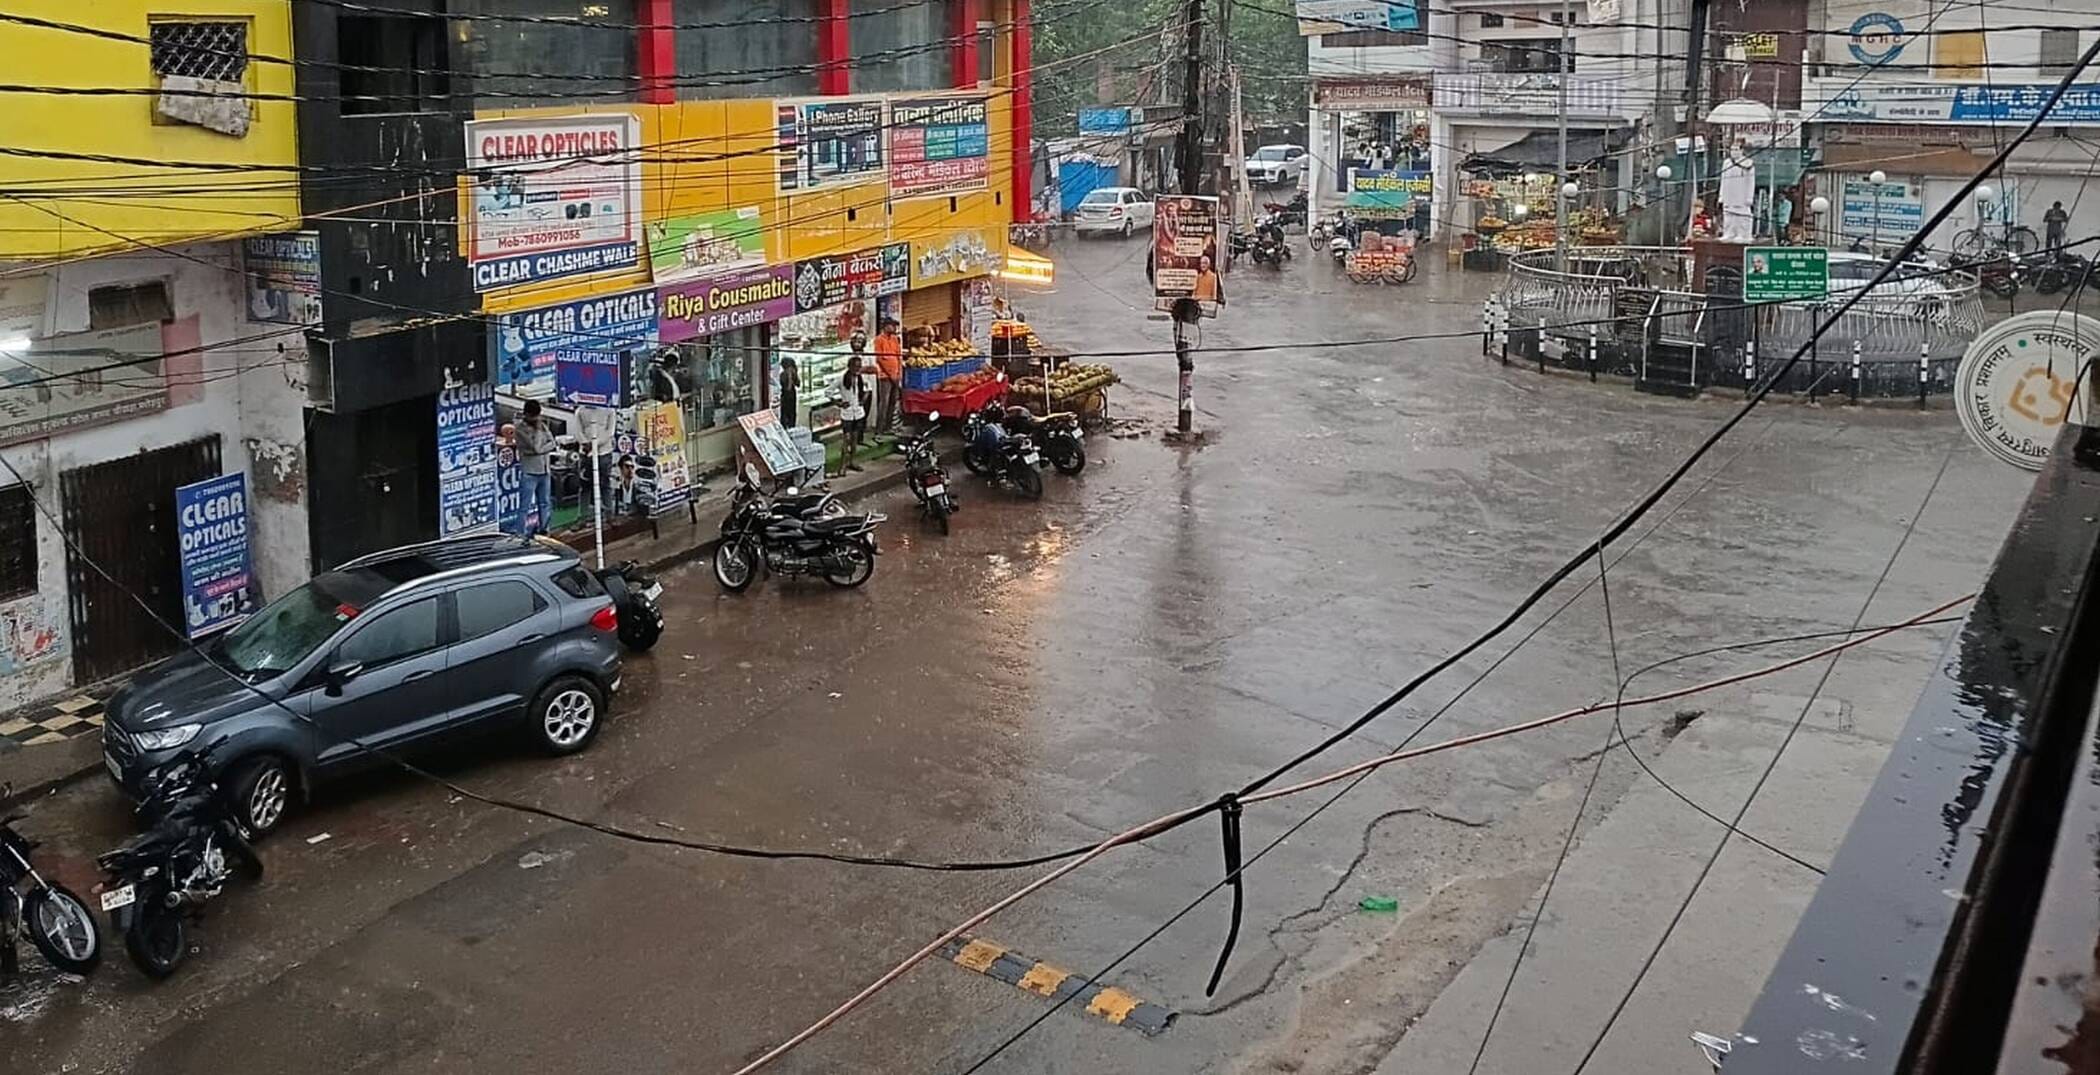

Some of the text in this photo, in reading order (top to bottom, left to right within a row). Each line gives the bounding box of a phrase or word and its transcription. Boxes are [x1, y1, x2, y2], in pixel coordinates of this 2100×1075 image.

[482, 130, 618, 162] CLEAR OPTICLES
[476, 259, 531, 286] CLEAR
[536, 250, 601, 276] CHASHME
[667, 293, 704, 319] Riya
[708, 277, 791, 311] Cousmatic
[524, 292, 656, 340] CLEAR OPTICALS
[697, 309, 766, 333] & Gift Center
[557, 350, 581, 363] CLEAR
[581, 351, 618, 365] OPTICALS
[438, 381, 493, 407] CLEAR
[437, 402, 494, 428] OPTICALS
[182, 491, 244, 528] CLEAR
[181, 516, 247, 551] OPTICALS
